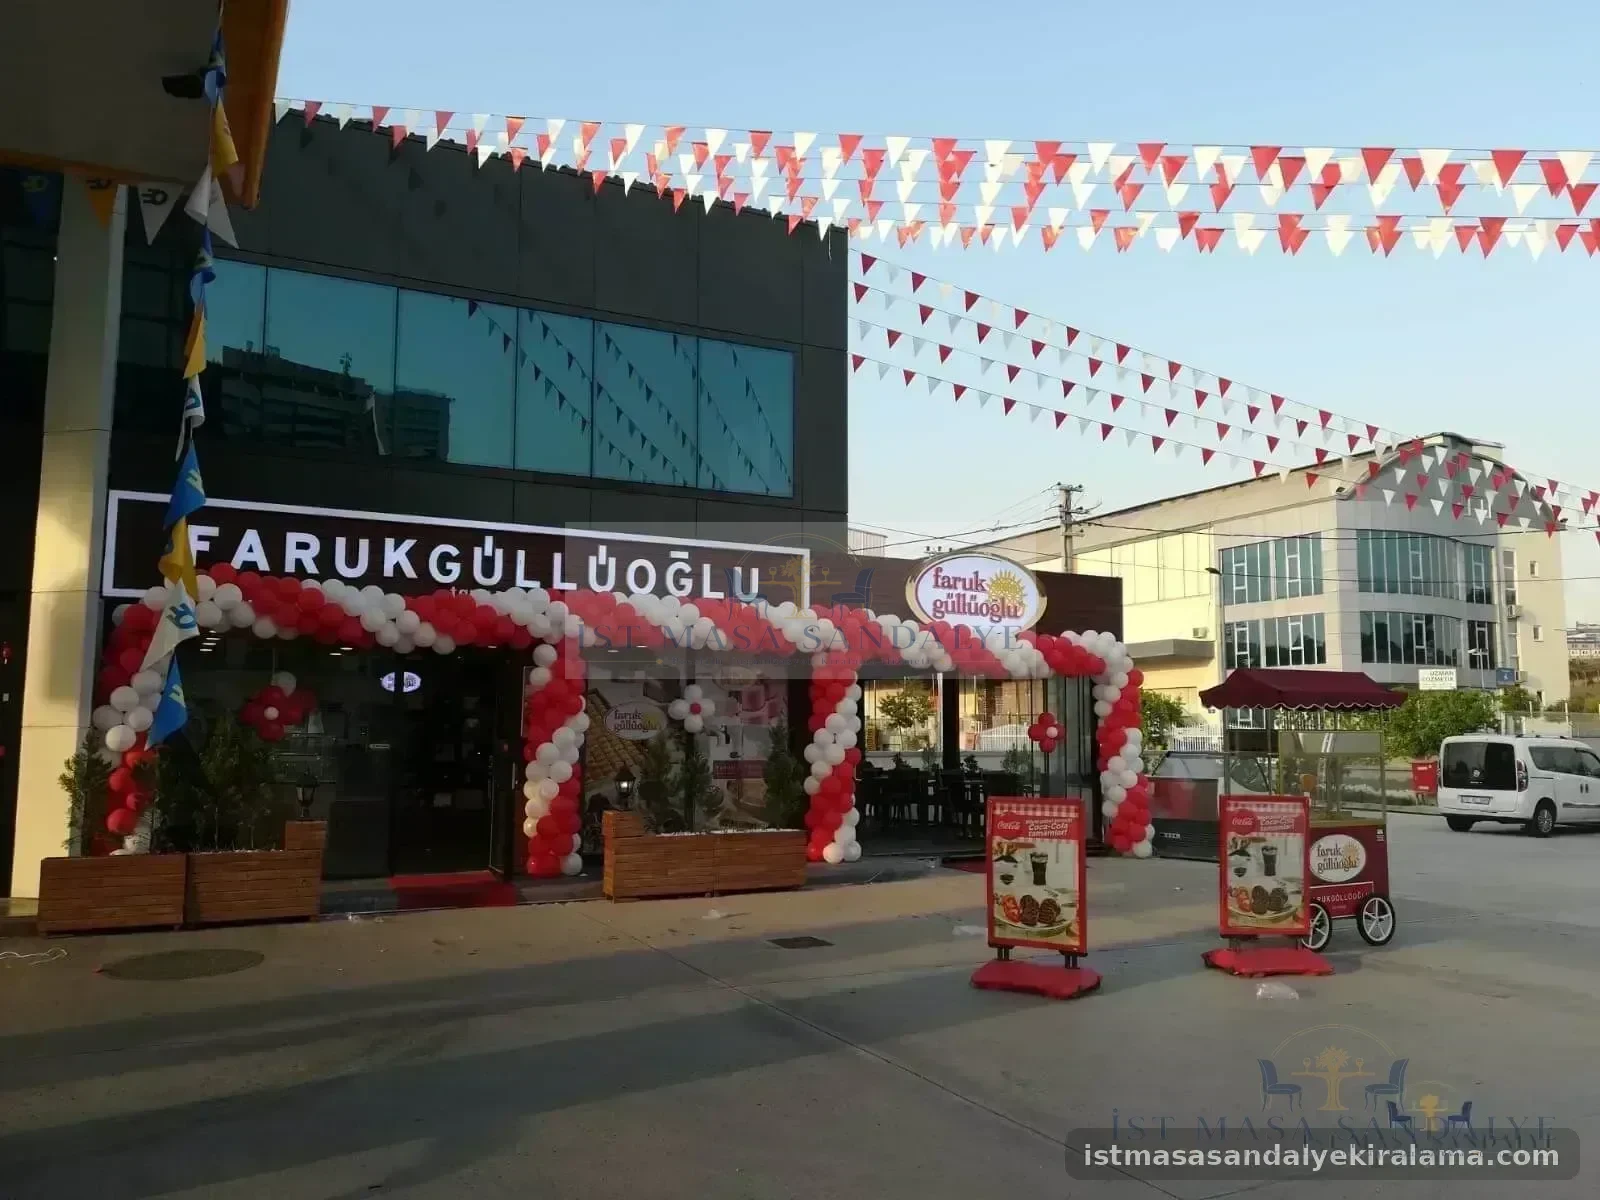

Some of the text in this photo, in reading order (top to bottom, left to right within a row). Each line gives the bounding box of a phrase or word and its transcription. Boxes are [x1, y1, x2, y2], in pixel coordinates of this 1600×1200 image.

[932, 567, 987, 592] faruk
[932, 592, 1021, 623] güllüoğlu
[1028, 822, 1069, 831] Coca-Cola
[1316, 842, 1343, 857] faruk
[1316, 856, 1358, 874] güllüoğlu
